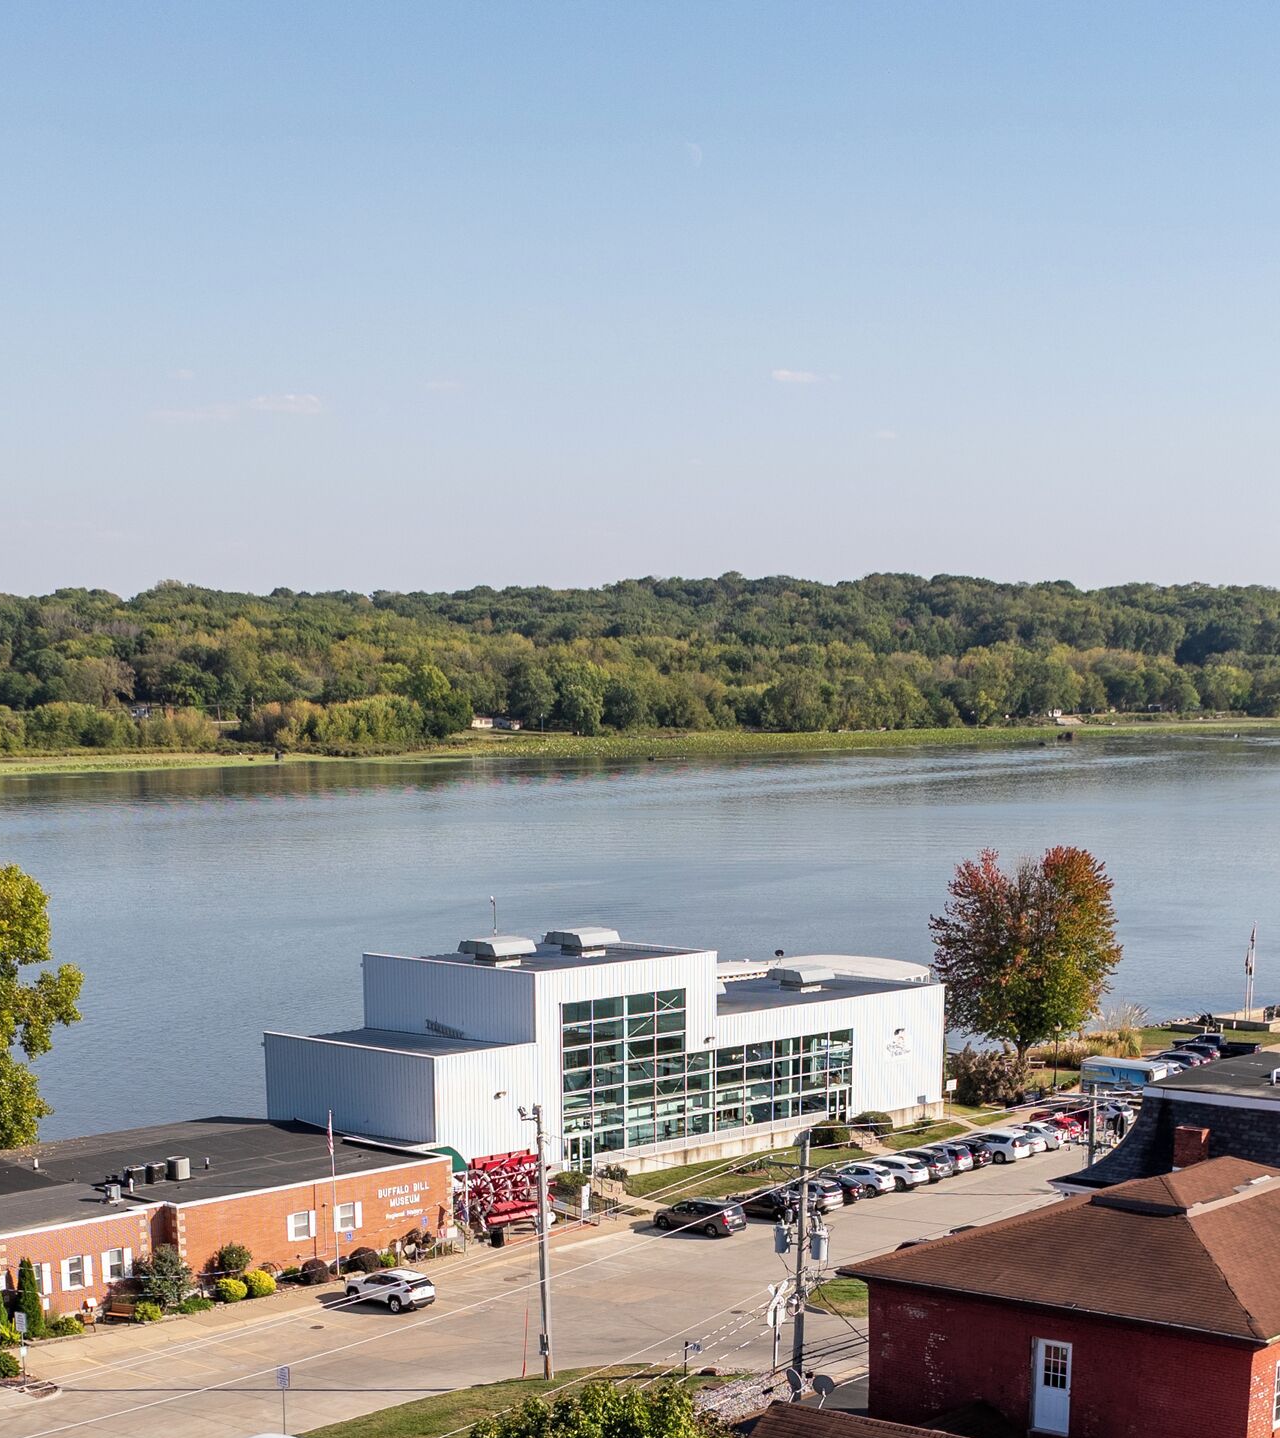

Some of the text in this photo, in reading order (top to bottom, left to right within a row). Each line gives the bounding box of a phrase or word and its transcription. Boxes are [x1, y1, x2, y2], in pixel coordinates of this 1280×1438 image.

[377, 1181, 430, 1199] BUFFALO BILL
[389, 1193, 421, 1208] MUSEUM
